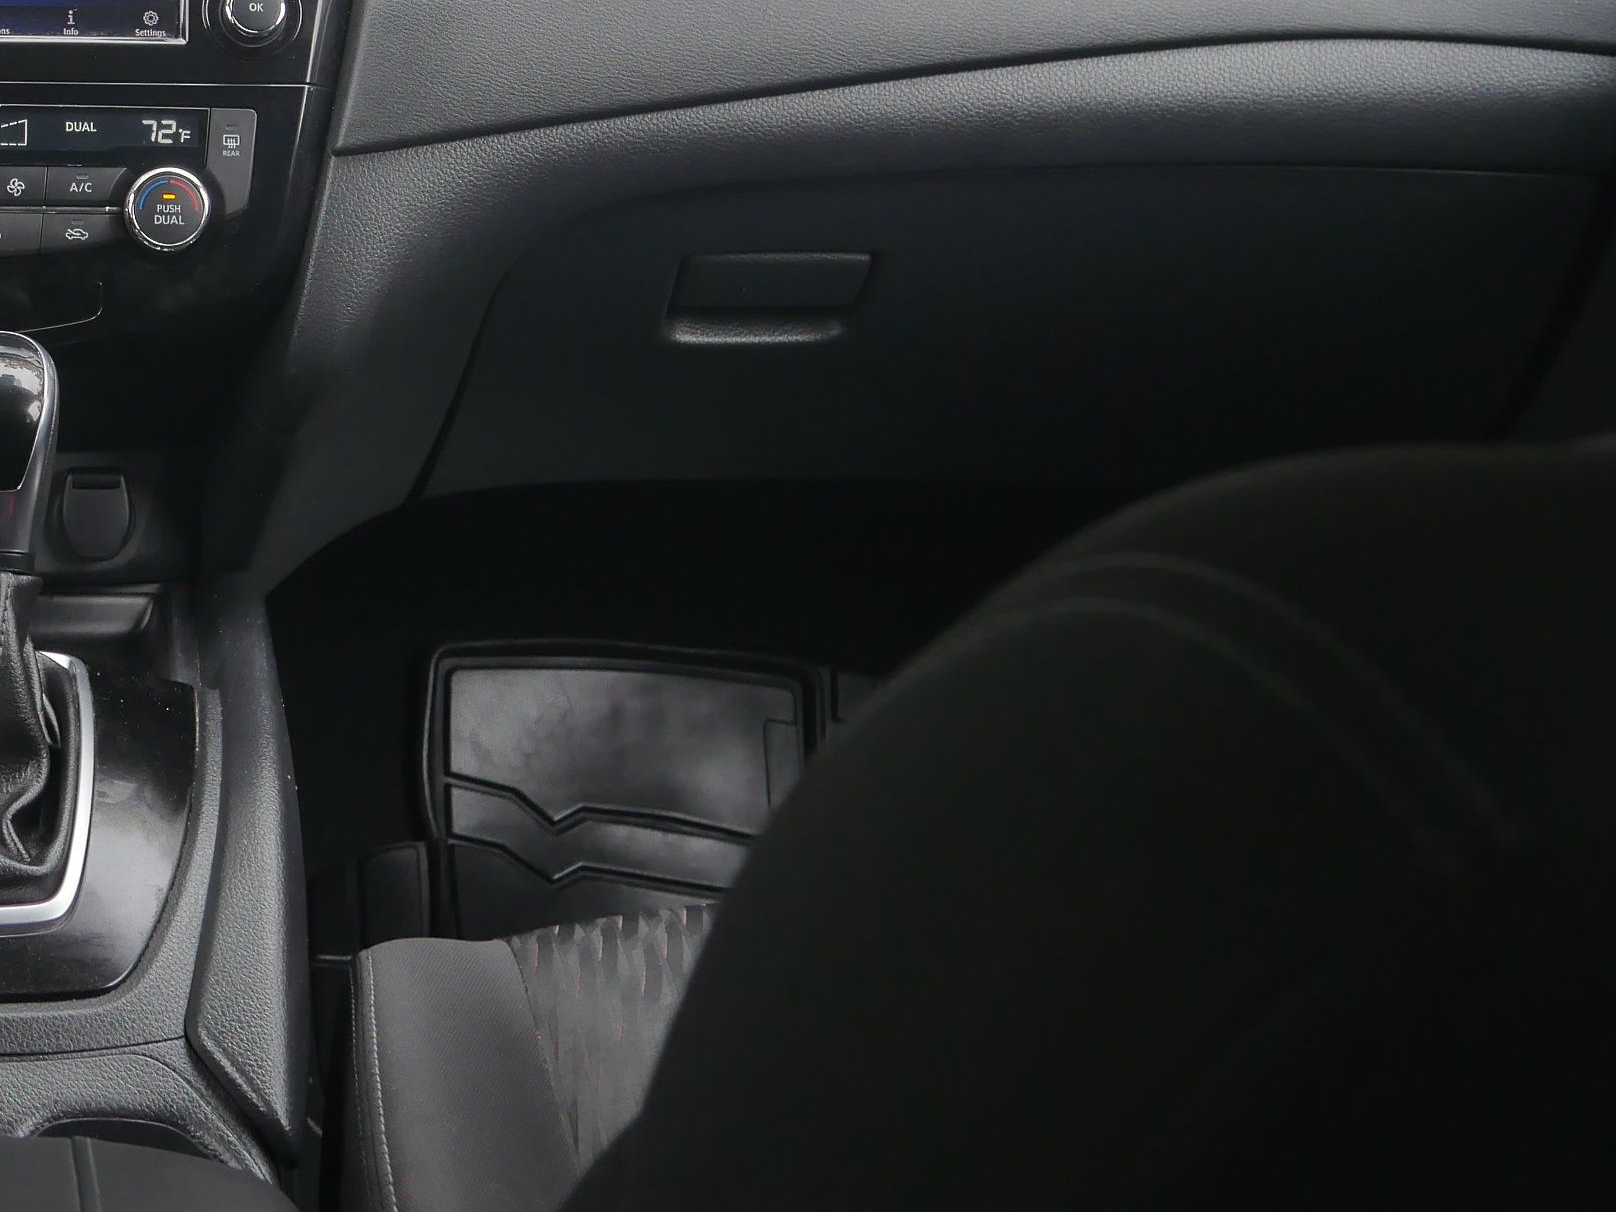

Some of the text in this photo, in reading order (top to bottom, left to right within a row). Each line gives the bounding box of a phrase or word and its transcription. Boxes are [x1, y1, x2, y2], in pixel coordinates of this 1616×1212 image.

[249, 2, 264, 13] OK
[63, 27, 79, 36] Info
[135, 29, 167, 37] Settings
[65, 121, 97, 133] DUAL
[222, 149, 240, 157] REAR
[69, 182, 93, 194] A/C
[156, 204, 181, 214] PUSH
[153, 214, 185, 226] DUAL
